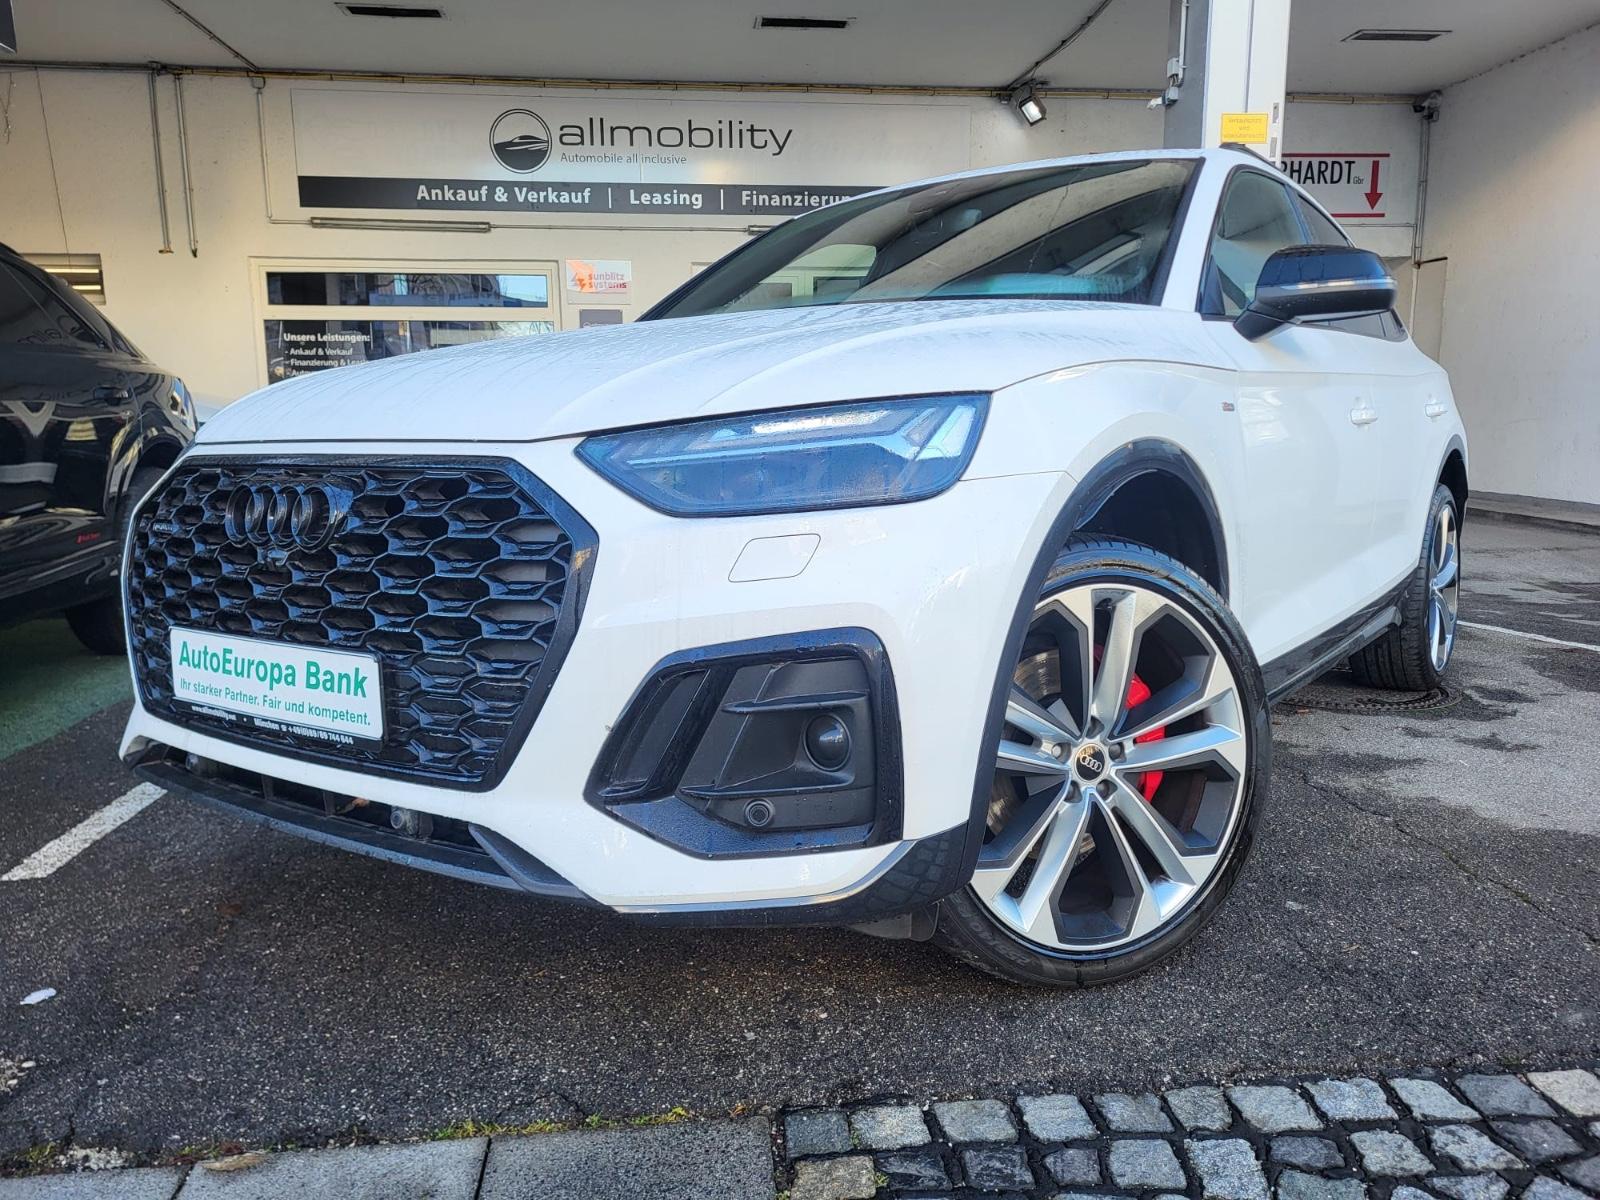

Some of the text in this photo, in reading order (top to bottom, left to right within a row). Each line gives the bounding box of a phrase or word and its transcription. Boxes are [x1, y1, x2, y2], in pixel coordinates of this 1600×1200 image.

[558, 116, 793, 157] allmobility
[560, 152, 687, 165] Automobile all inclusive
[416, 184, 488, 202] Ankauf
[494, 186, 509, 203] &
[514, 186, 591, 205] Verkauf
[629, 188, 703, 210] Leasing
[588, 271, 625, 281] sunblitz
[588, 281, 628, 291] systems
[283, 332, 371, 344] Unsere Leistungen:
[289, 347, 353, 356] Ankauf & Verkauf
[290, 358, 339, 368] Finanzierung
[178, 640, 368, 698] AutoEuropa Bank
[180, 677, 371, 726] Ihr starker Partner. Fair und kompetent.
